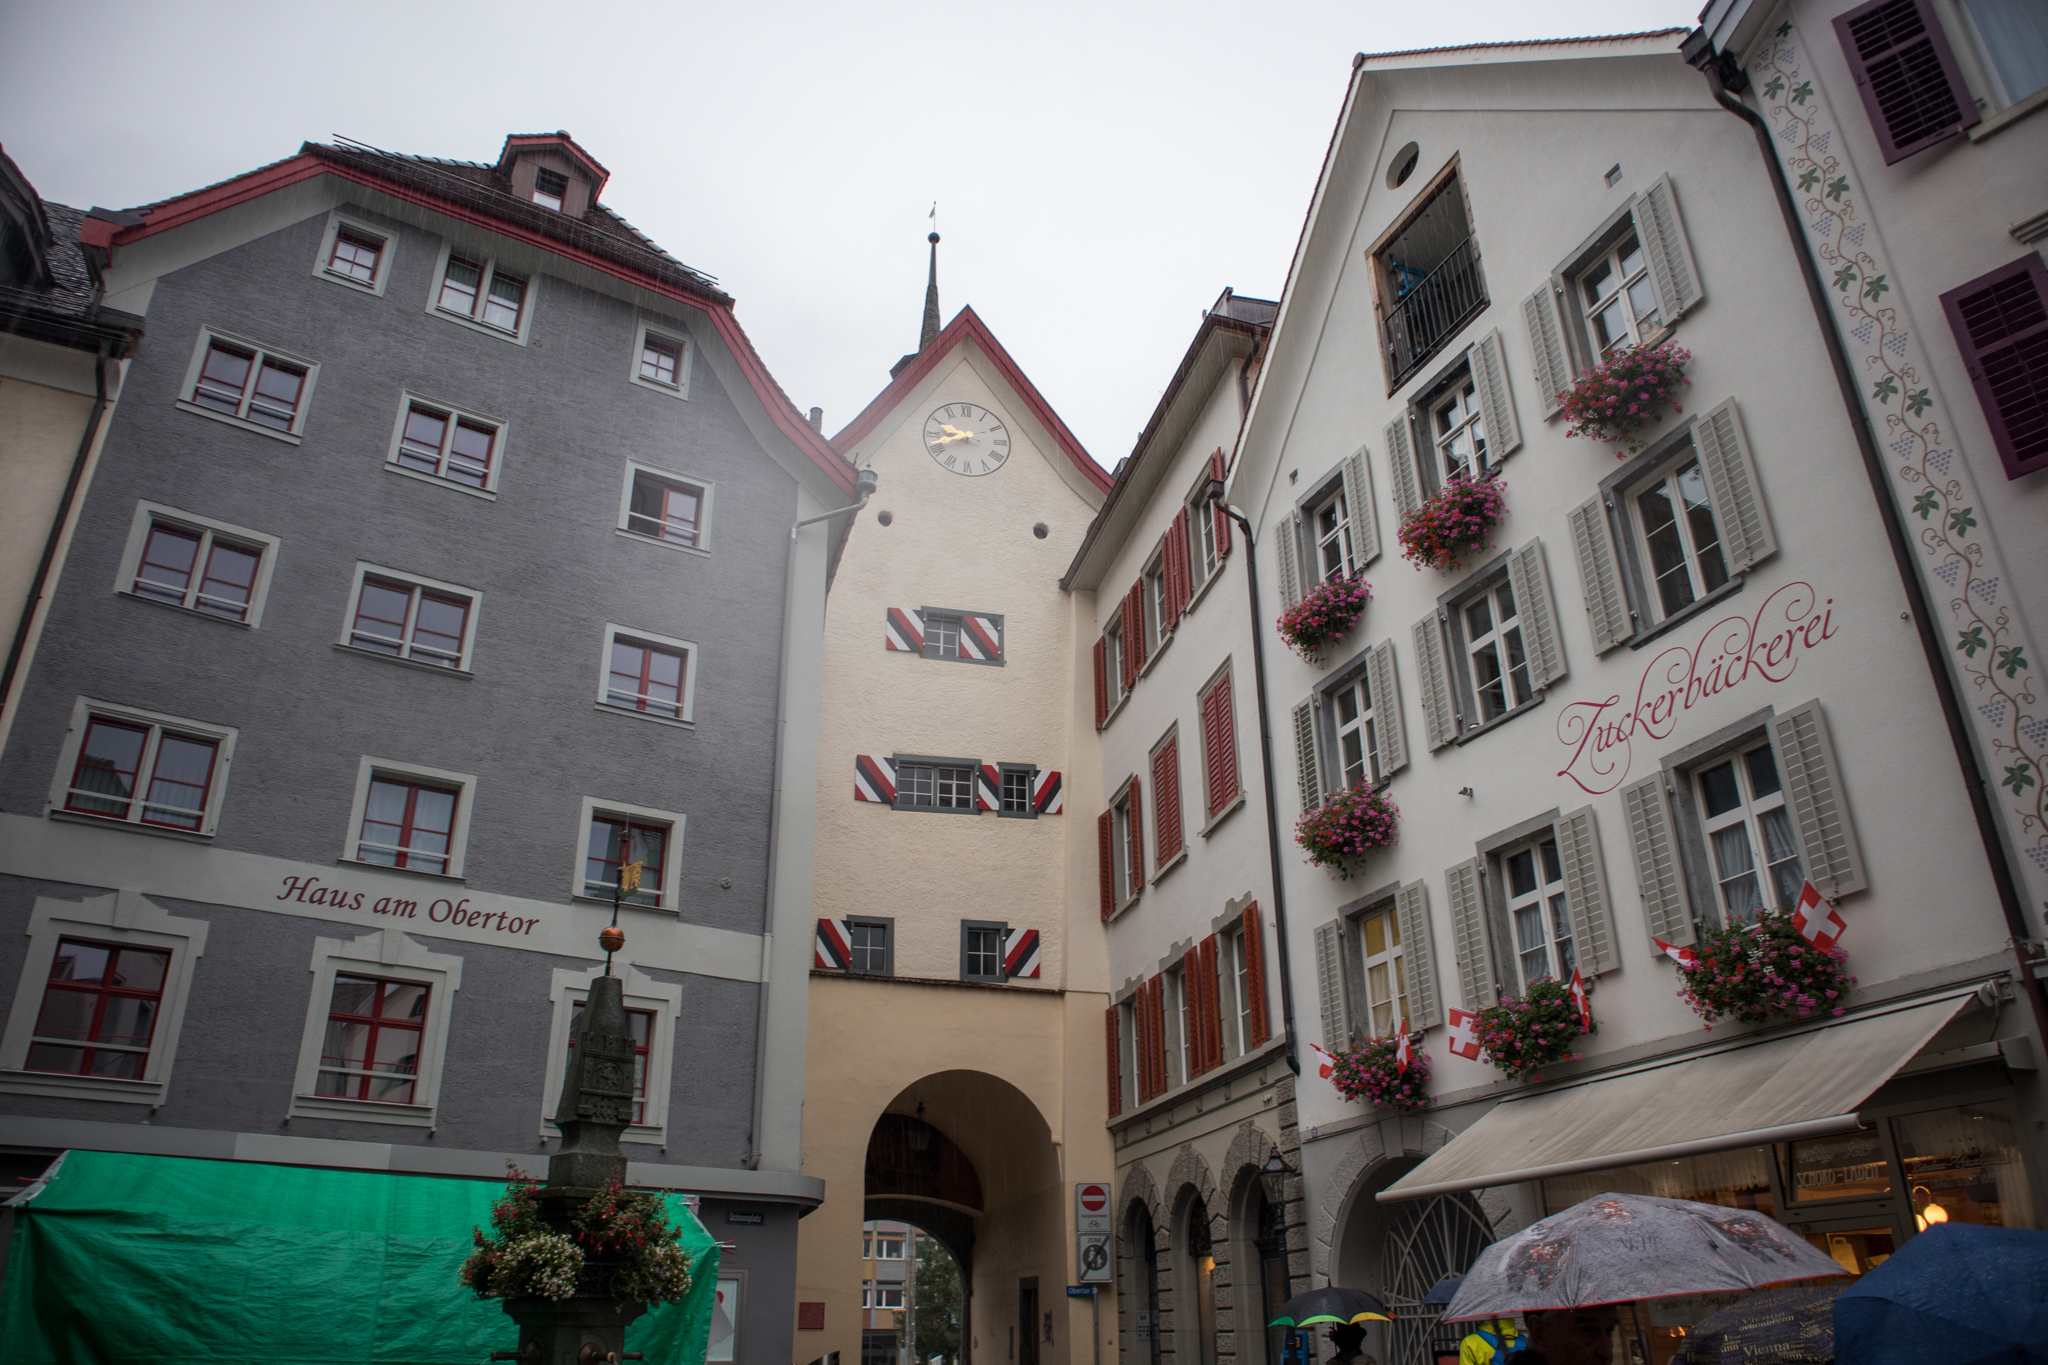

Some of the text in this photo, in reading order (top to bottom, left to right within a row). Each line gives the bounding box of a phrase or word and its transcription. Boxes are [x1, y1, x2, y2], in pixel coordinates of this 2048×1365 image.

[944, 407, 956, 419] XI
[961, 405, 972, 418] XII
[1557, 581, 1839, 795] Zuckerbäckerei
[276, 876, 540, 936] Haus am Obertor
[730, 1212, 762, 1223] Ochsenplatz
[1743, 1342, 1790, 1357] Vienna
